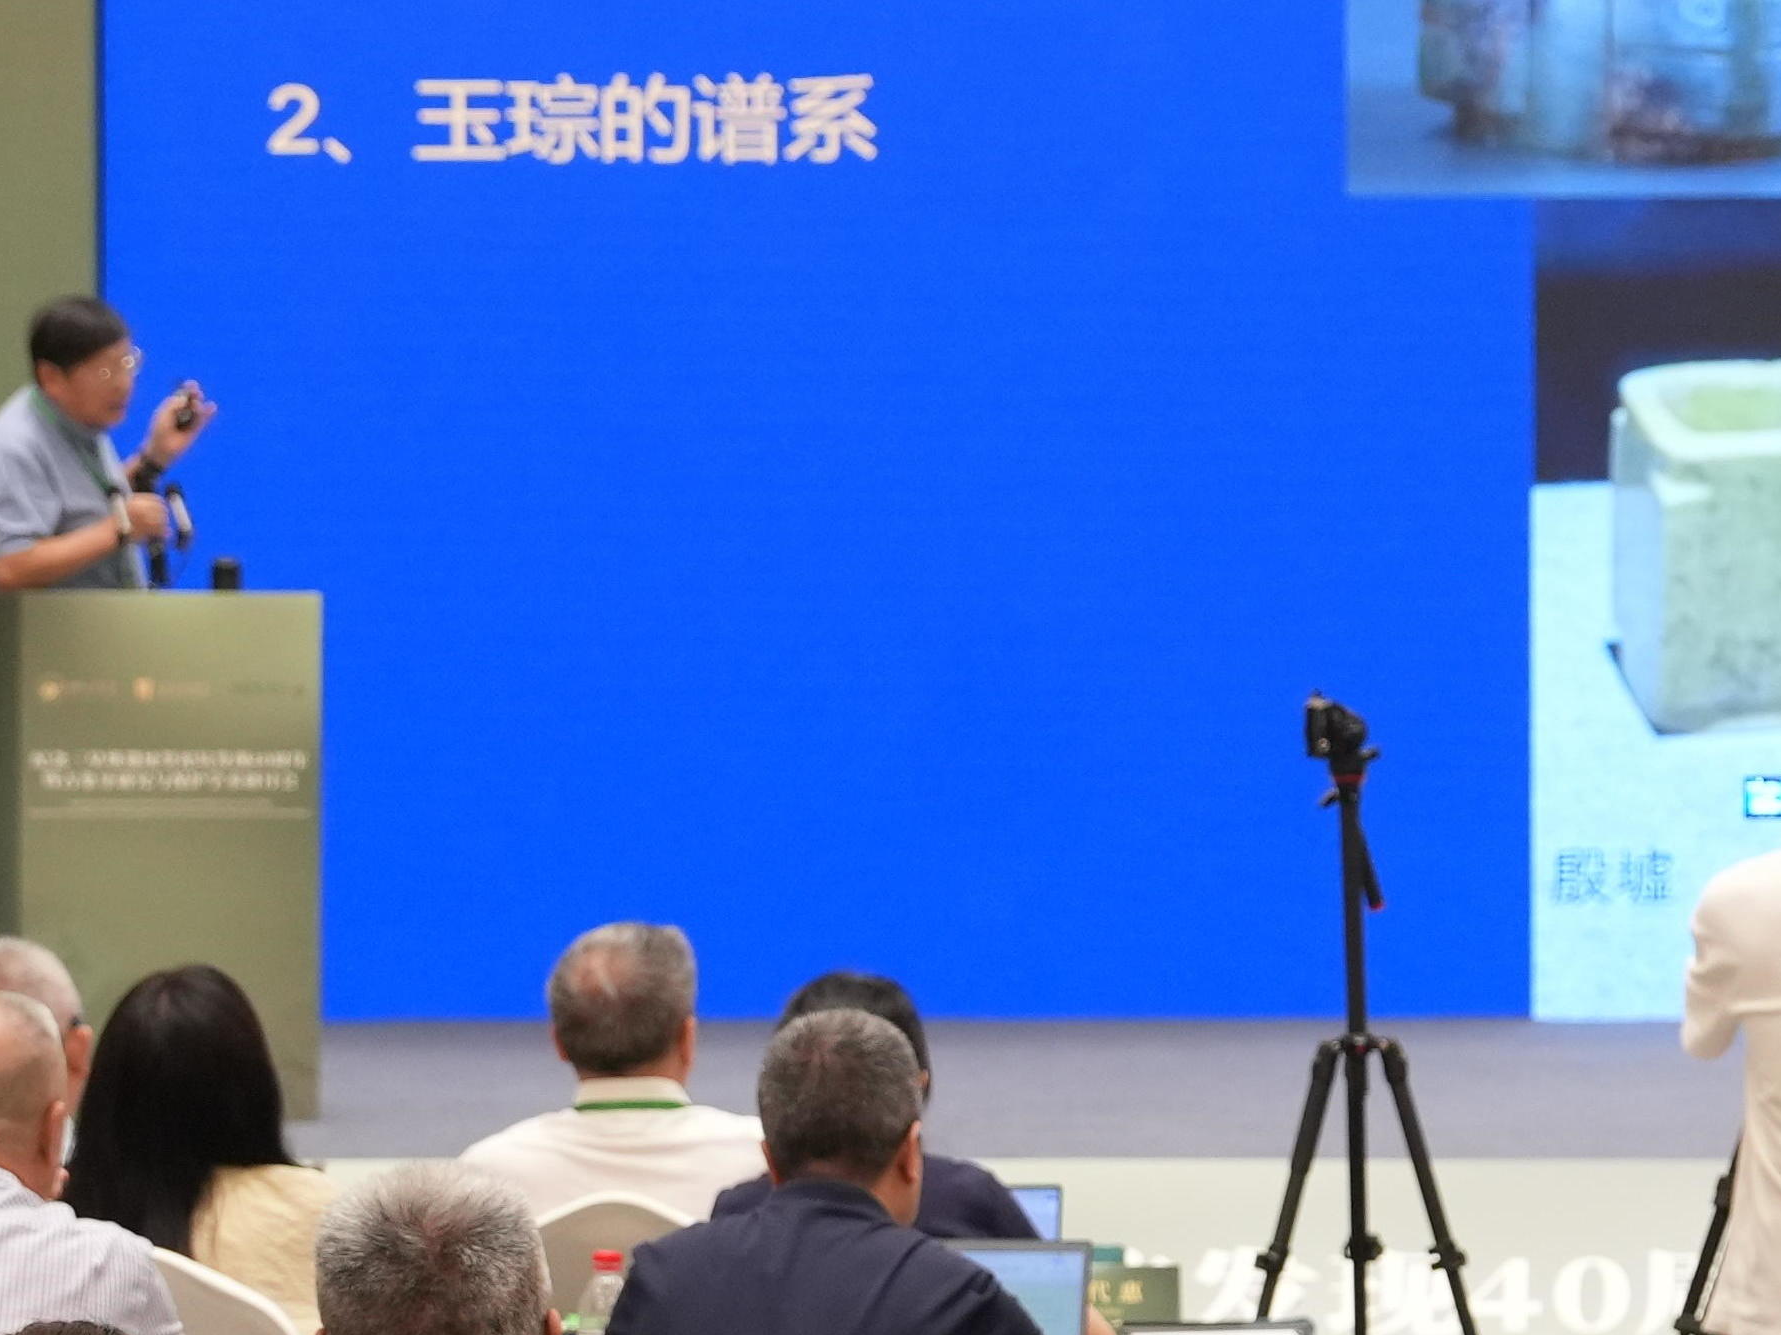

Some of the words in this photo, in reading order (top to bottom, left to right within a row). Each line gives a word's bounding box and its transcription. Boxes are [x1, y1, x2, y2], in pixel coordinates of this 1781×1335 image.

[266, 72, 879, 166] 2、玉琮的谱系
